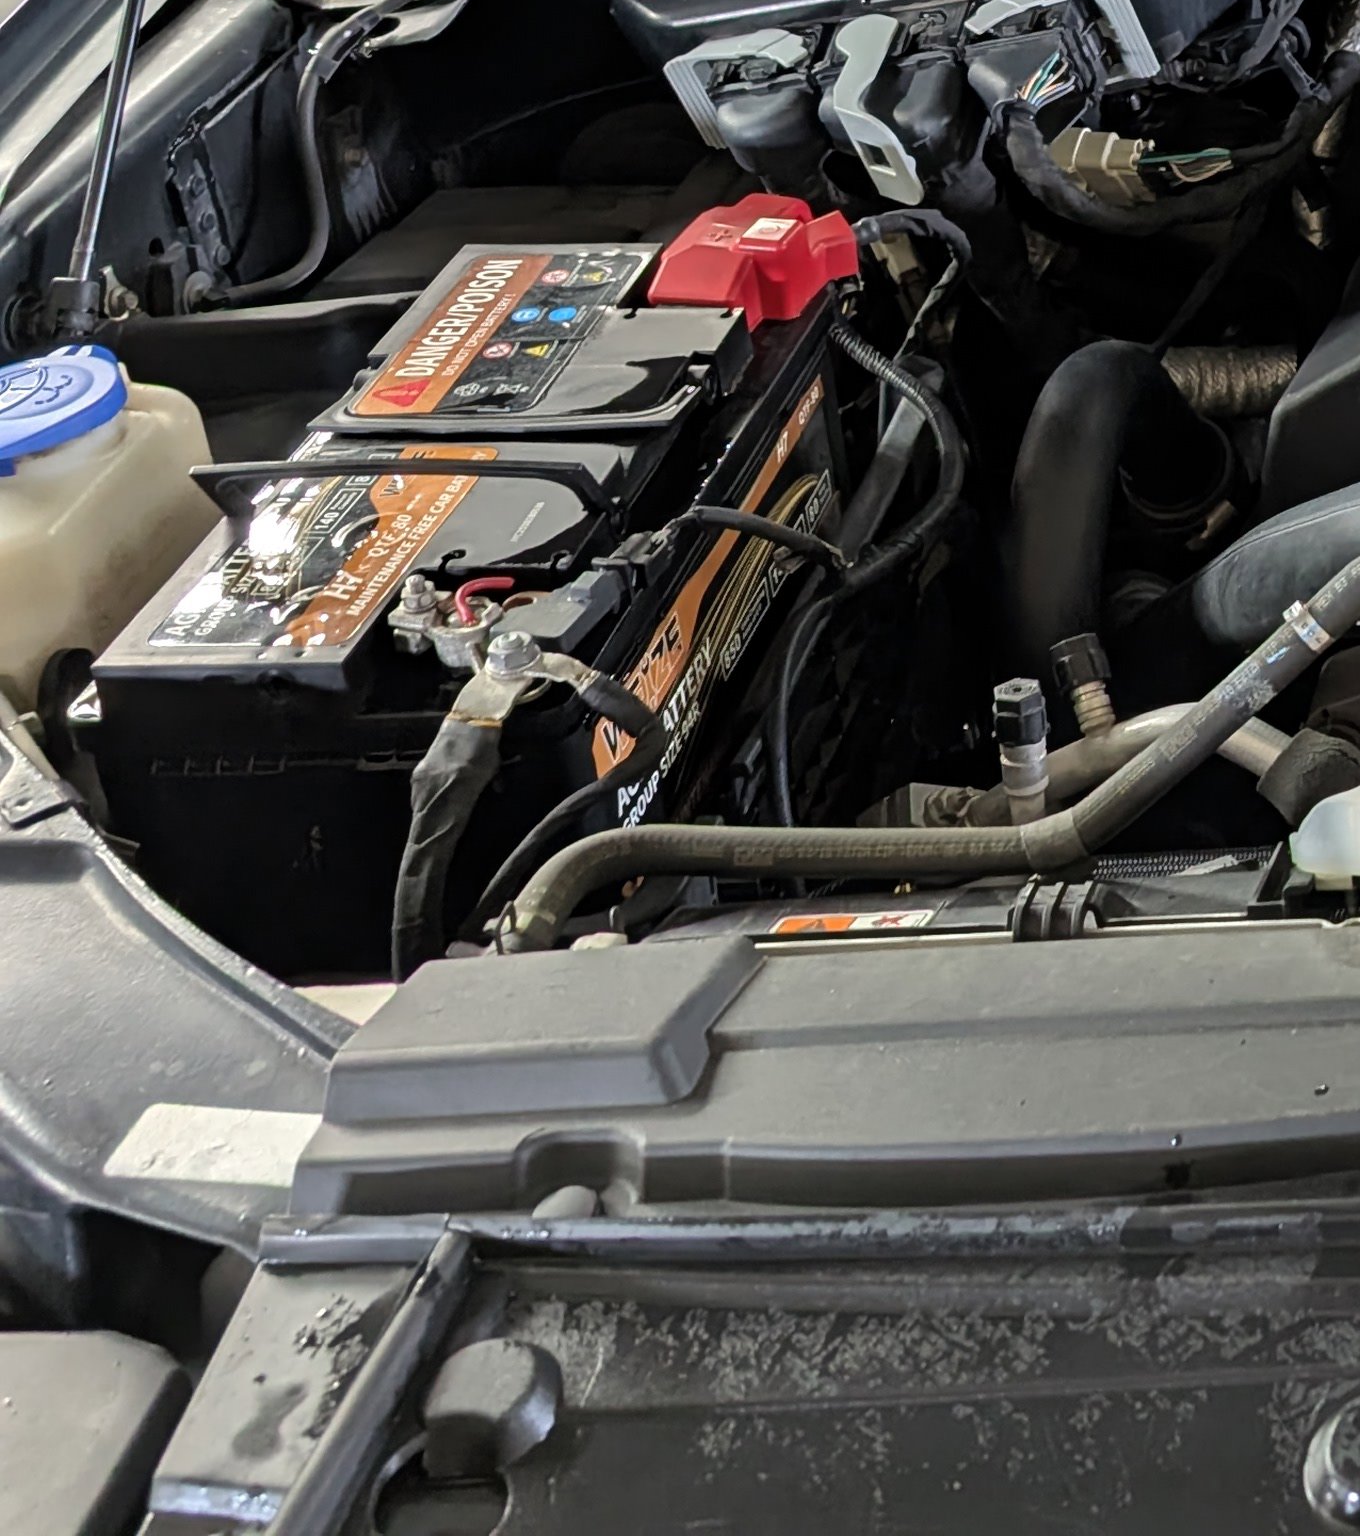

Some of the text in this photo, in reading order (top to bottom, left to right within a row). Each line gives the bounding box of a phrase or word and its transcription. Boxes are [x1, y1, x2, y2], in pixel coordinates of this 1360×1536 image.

[395, 259, 524, 378] DANGER/POISON
[798, 386, 821, 425] QTF-80
[776, 430, 790, 464] H7
[314, 512, 340, 531] 140
[347, 542, 412, 617] MAINTENANCE
[409, 508, 438, 544] FREE
[429, 491, 456, 515] CAR
[662, 637, 716, 733] ATTERY
[659, 735, 684, 779] SIZE
